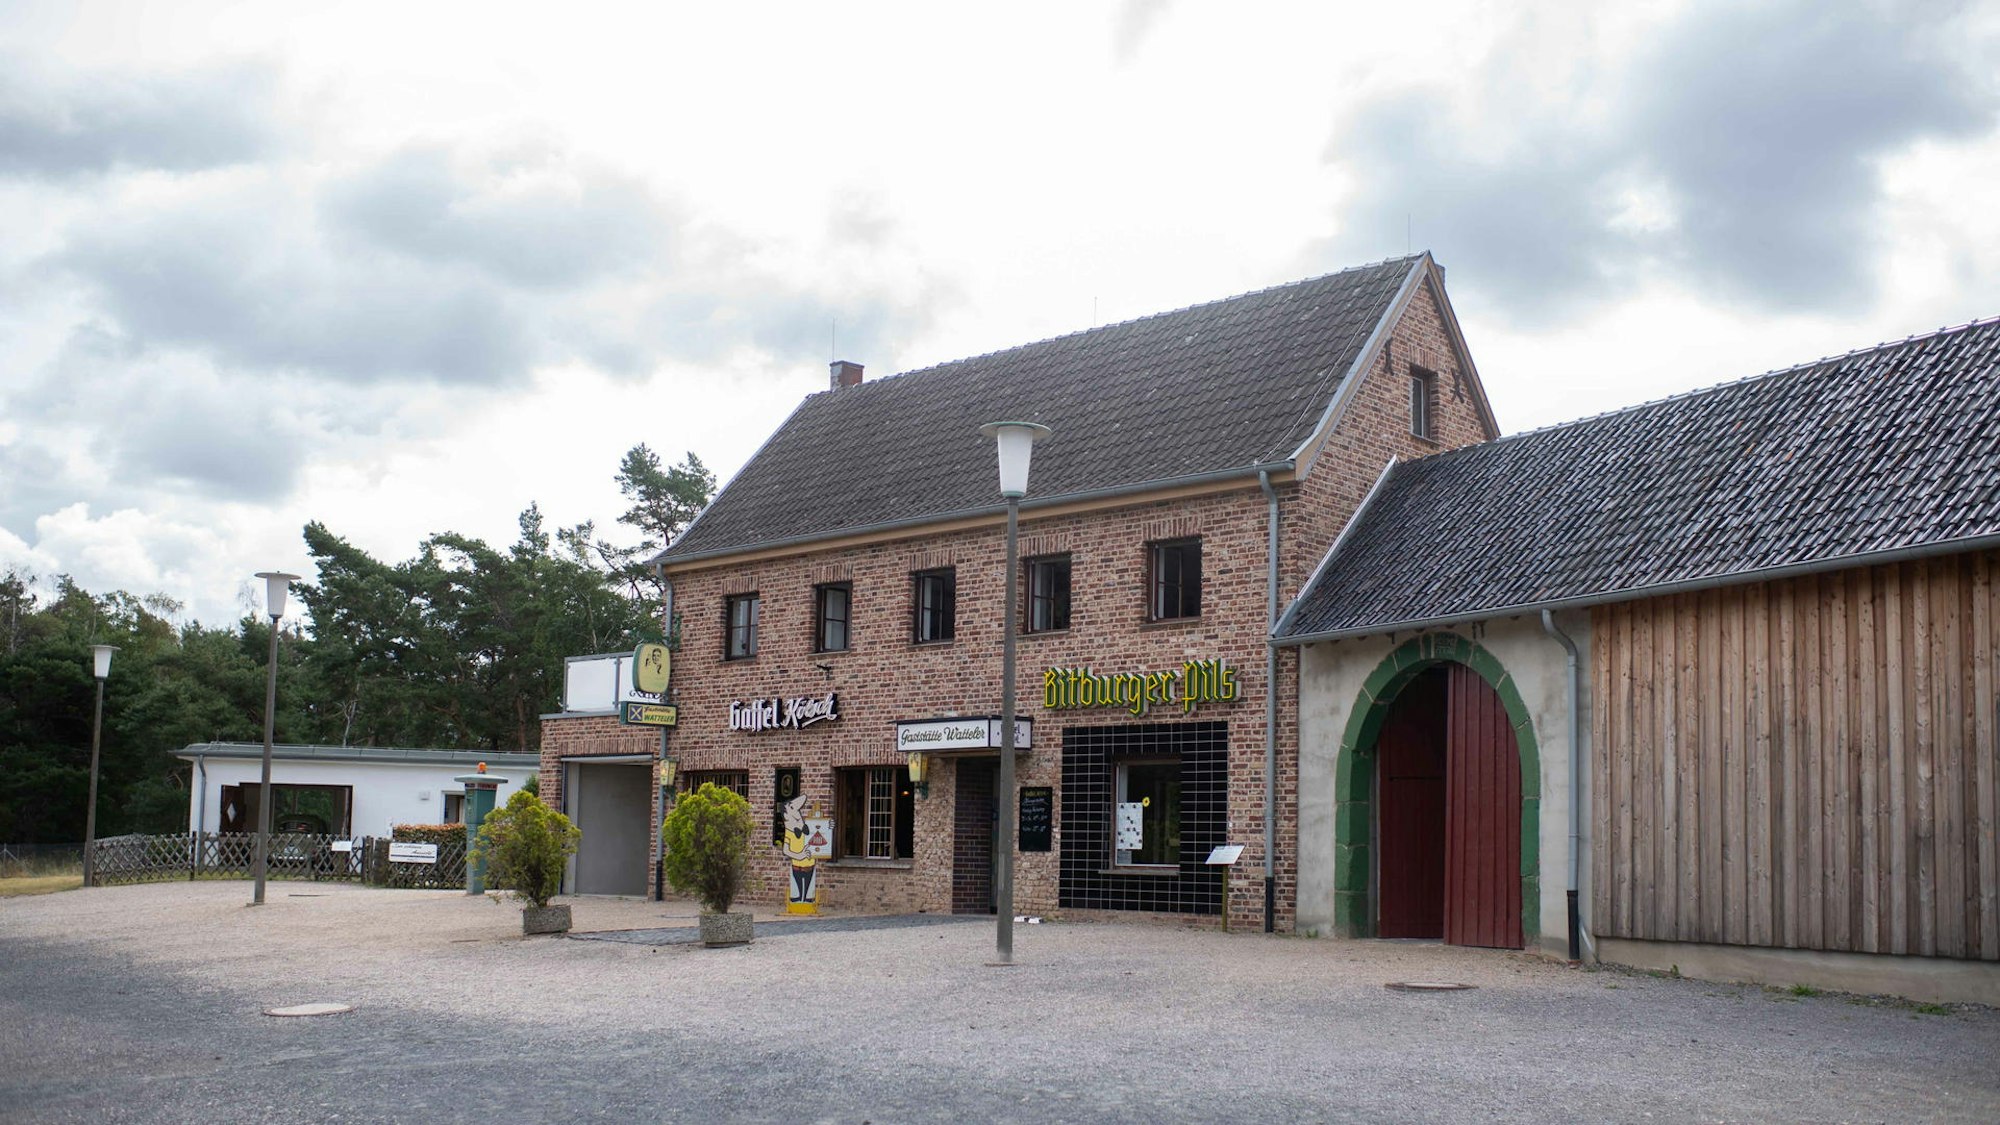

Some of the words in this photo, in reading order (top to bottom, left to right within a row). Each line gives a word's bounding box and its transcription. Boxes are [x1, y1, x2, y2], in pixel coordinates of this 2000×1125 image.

[1043, 667, 1179, 716] Bitburger
[1182, 658, 1239, 714] Pils
[644, 714, 675, 722] WATTELER
[730, 698, 780, 732] Gaffel
[780, 692, 838, 730] Kölsch
[901, 729, 943, 746] Gaststätte
[944, 726, 985, 741] Watteler
